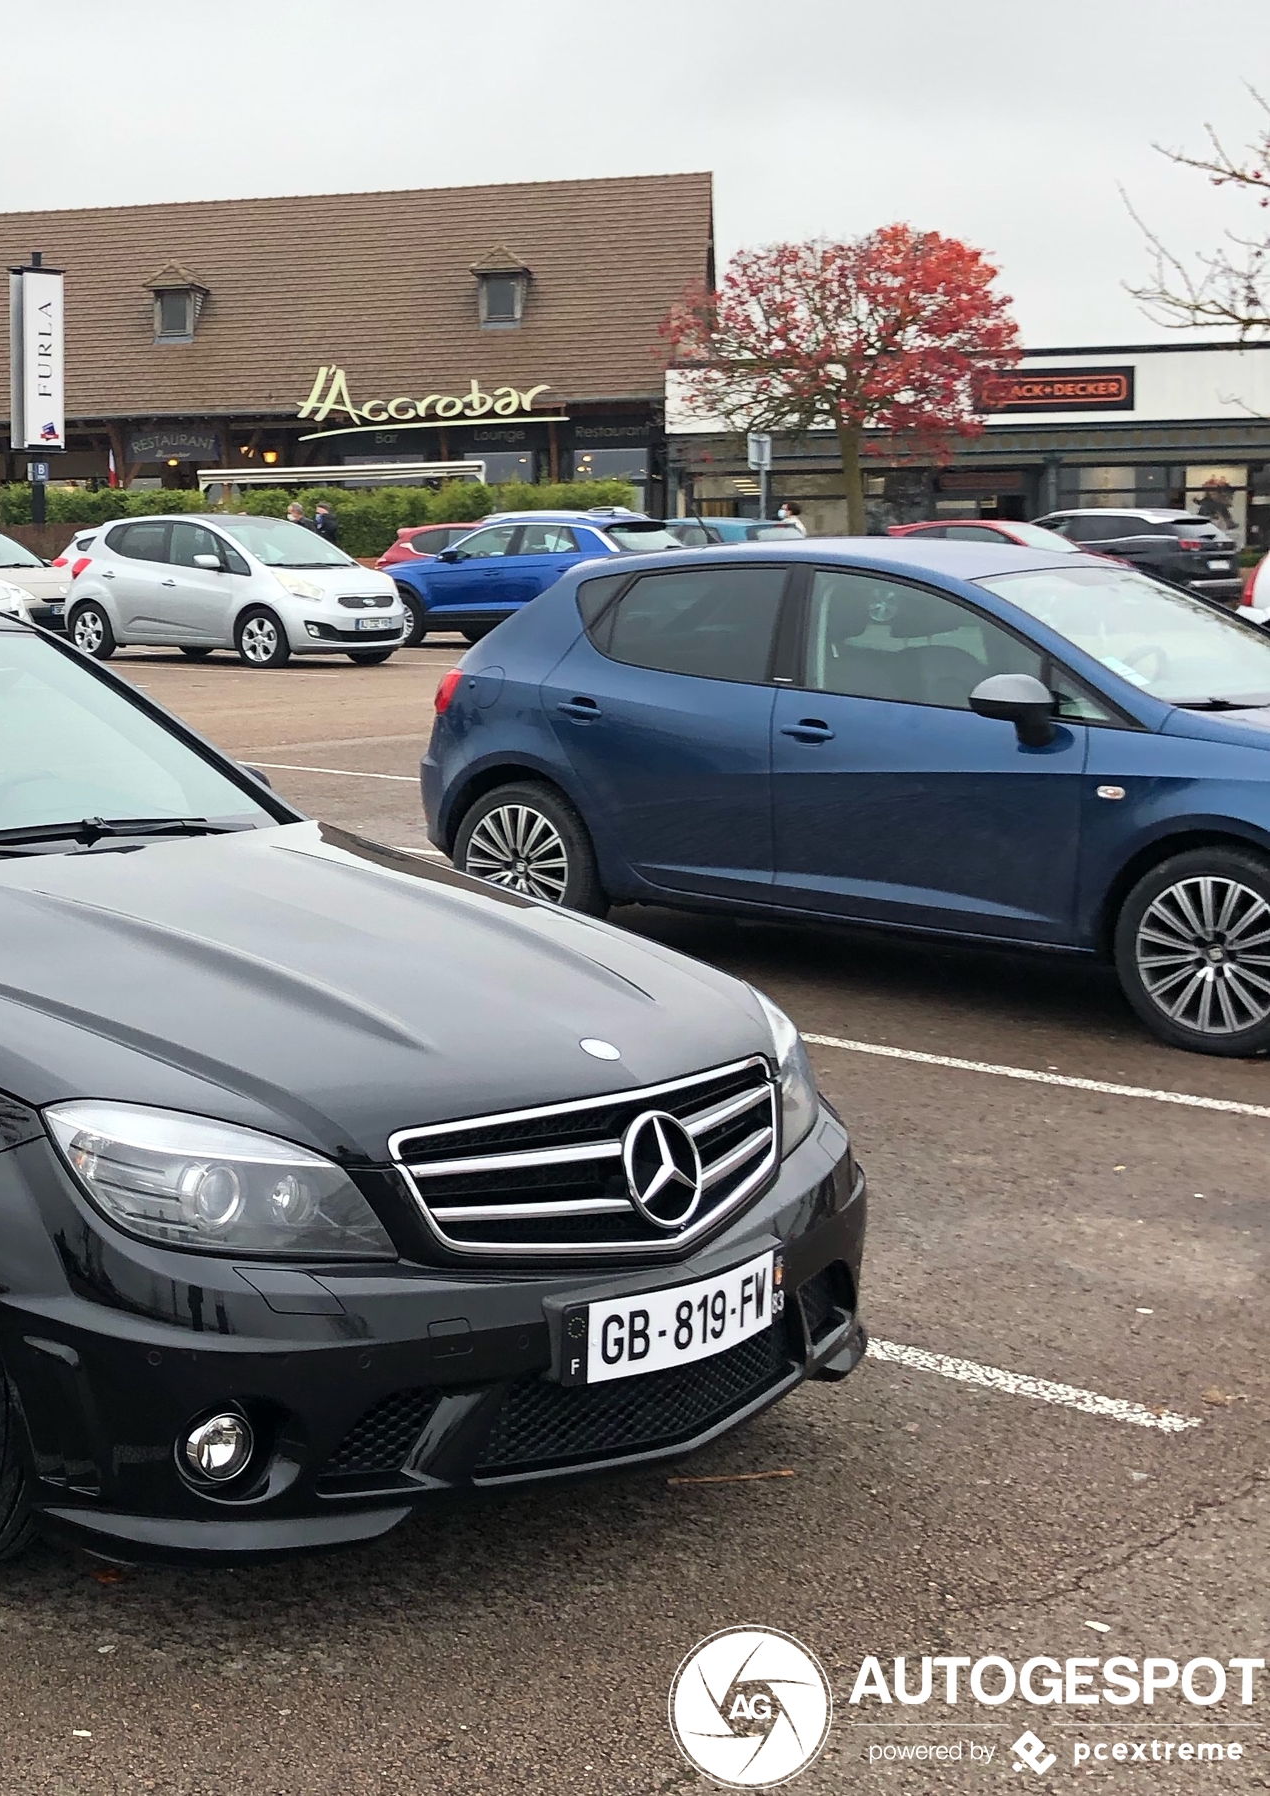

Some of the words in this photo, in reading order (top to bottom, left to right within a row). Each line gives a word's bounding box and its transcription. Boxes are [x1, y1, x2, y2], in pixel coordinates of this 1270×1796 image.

[38, 301, 52, 397] FURLA
[1009, 382, 1120, 398] ACK+DECKER
[374, 432, 398, 444] Bar
[473, 427, 526, 443] Lounge
[575, 424, 650, 438] Restaurant
[131, 434, 216, 454] RESTAURANT
[601, 1267, 767, 1365] GB-819-FW
[570, 1358, 580, 1375] F
